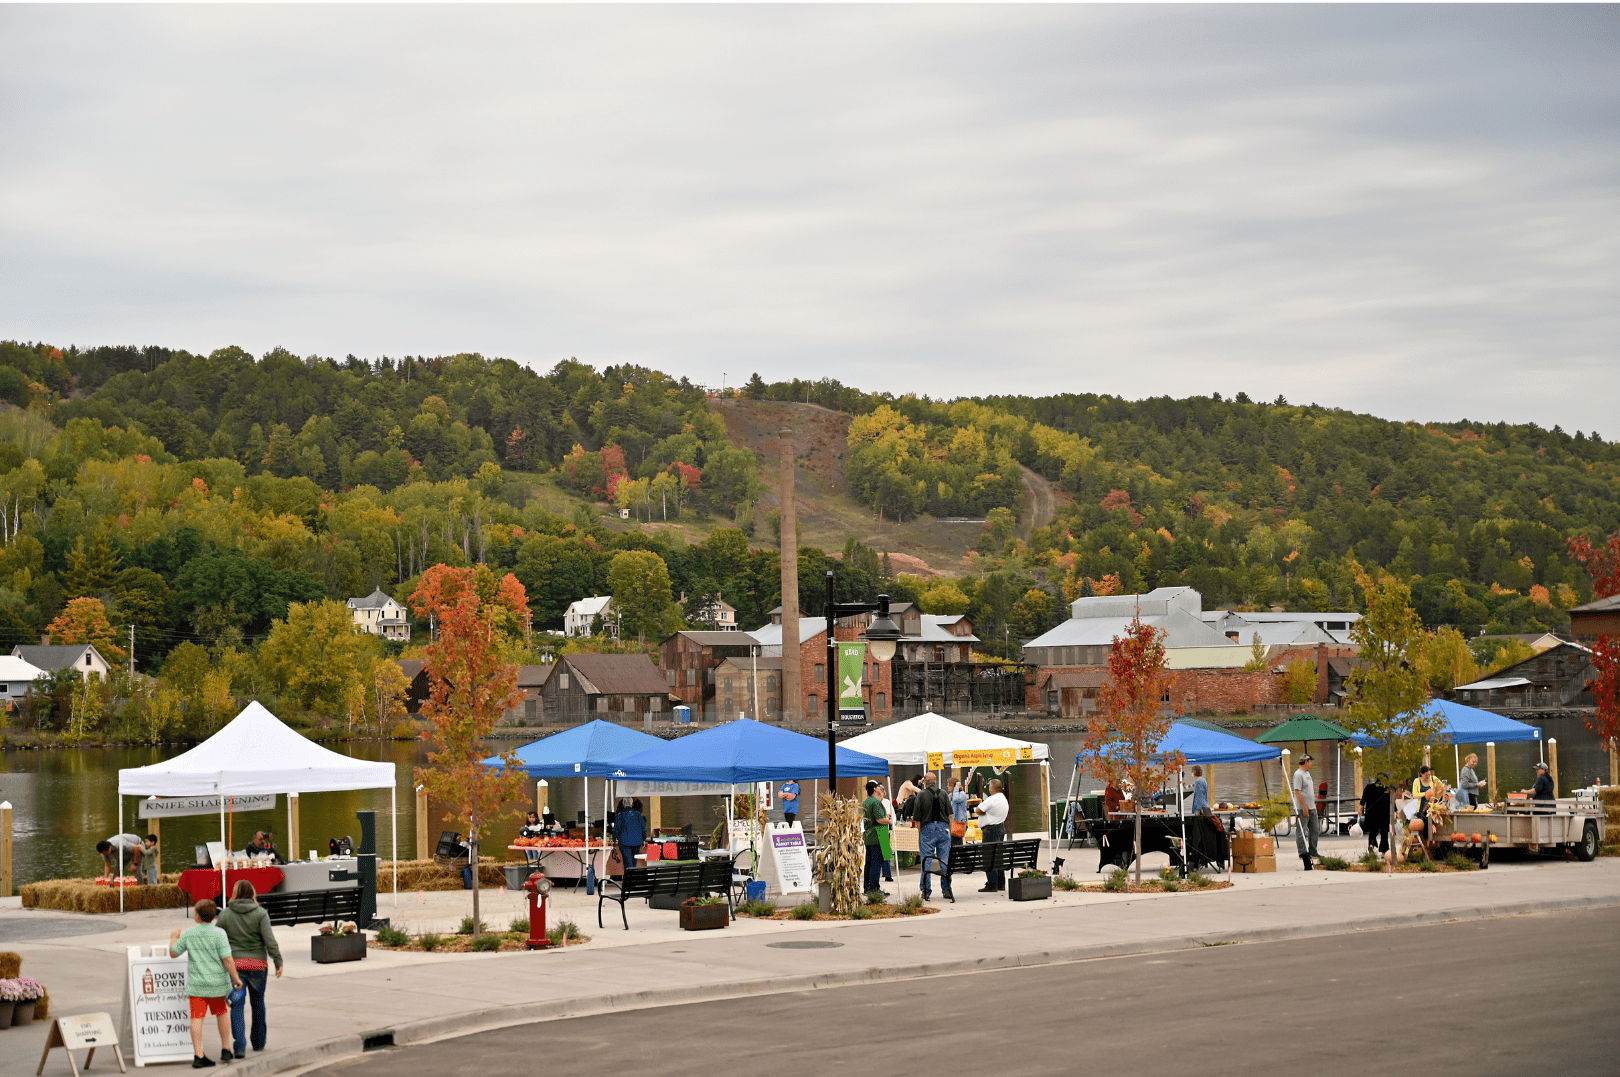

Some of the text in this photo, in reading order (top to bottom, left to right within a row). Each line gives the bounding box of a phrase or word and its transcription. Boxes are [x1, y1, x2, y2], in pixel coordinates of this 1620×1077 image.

[845, 648, 859, 656] READ
[145, 801, 185, 811] KNIFE
[188, 794, 270, 808] SHARPENING
[154, 972, 185, 981] DOWN
[154, 980, 185, 988] TOWN
[144, 1009, 189, 1022] TUESDAYS
[140, 1025, 159, 1035] 4:00
[166, 1023, 191, 1034] 7:00P
